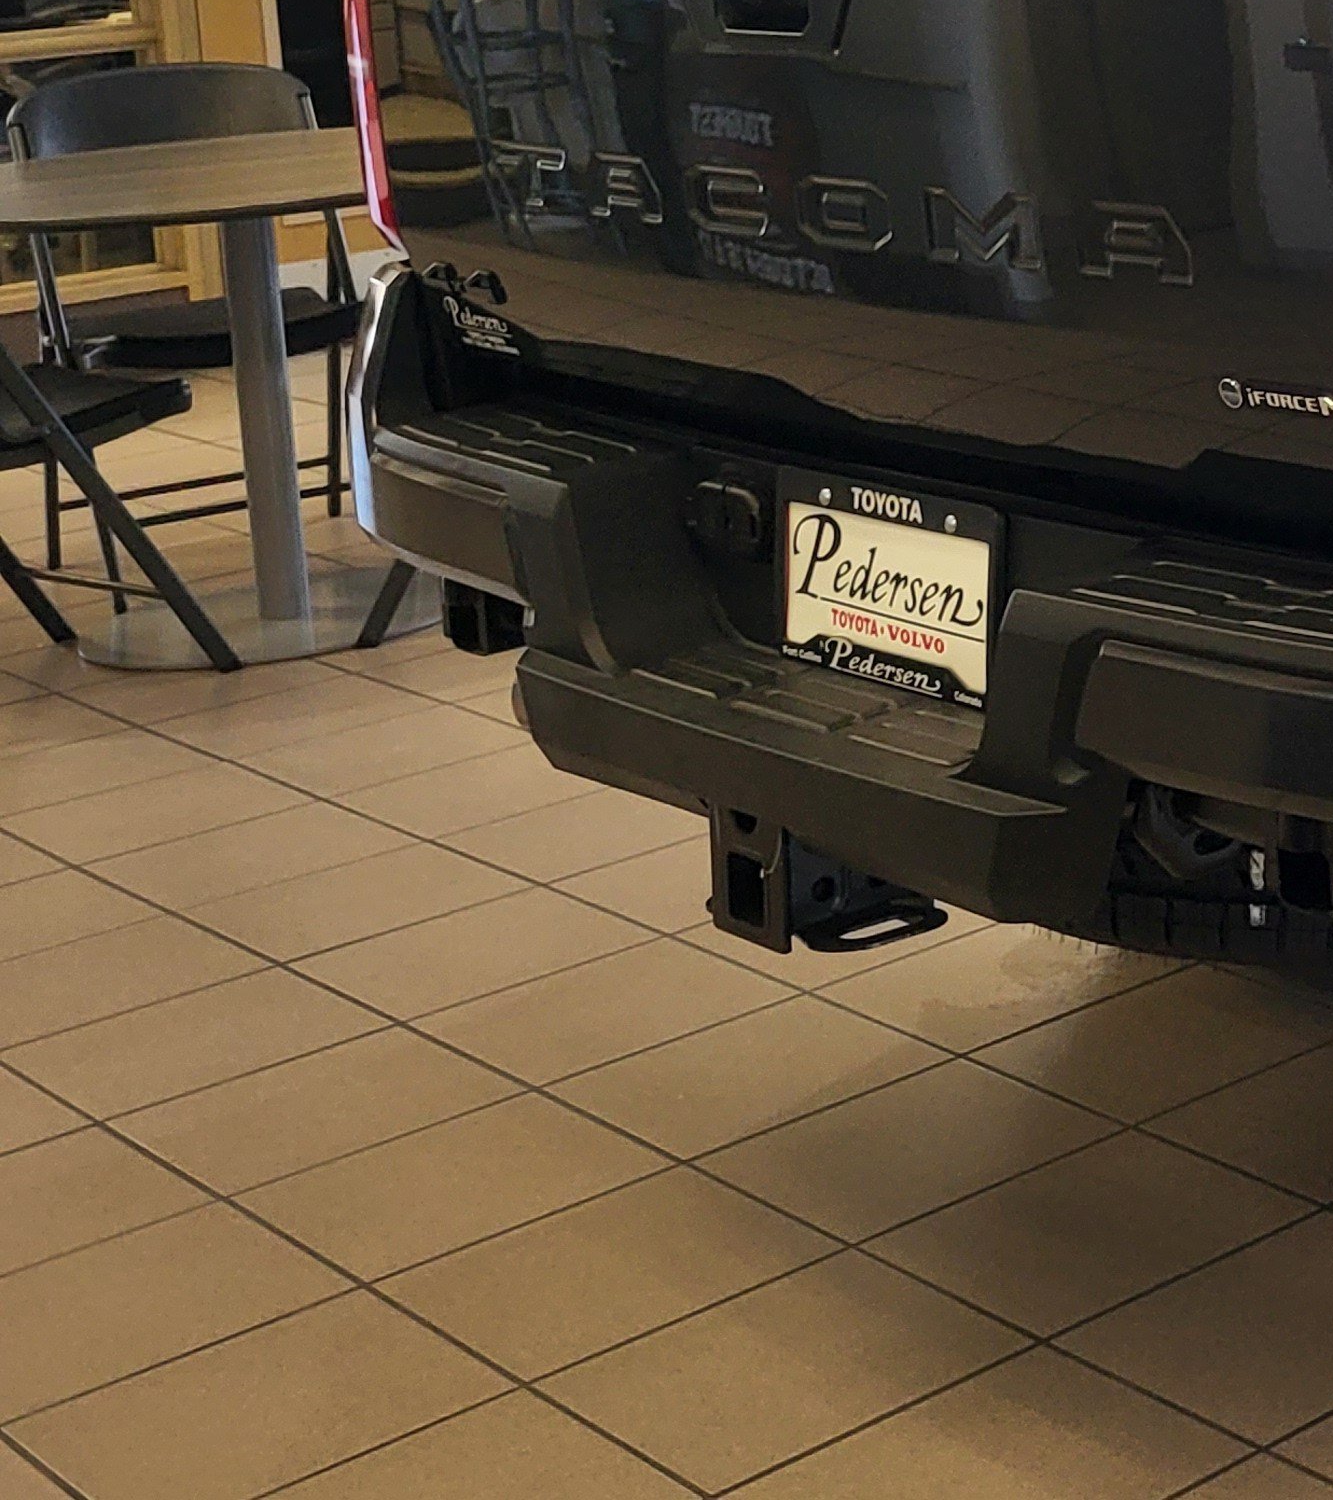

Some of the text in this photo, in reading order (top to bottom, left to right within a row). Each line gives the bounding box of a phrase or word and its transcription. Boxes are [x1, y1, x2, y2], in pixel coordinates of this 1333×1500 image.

[494, 138, 1196, 289] TACOMA
[850, 486, 923, 525] TOYOTA
[793, 513, 984, 627] Pedersen
[831, 607, 945, 654] TOYOTA VOLVO
[824, 637, 942, 693] Pedersen
